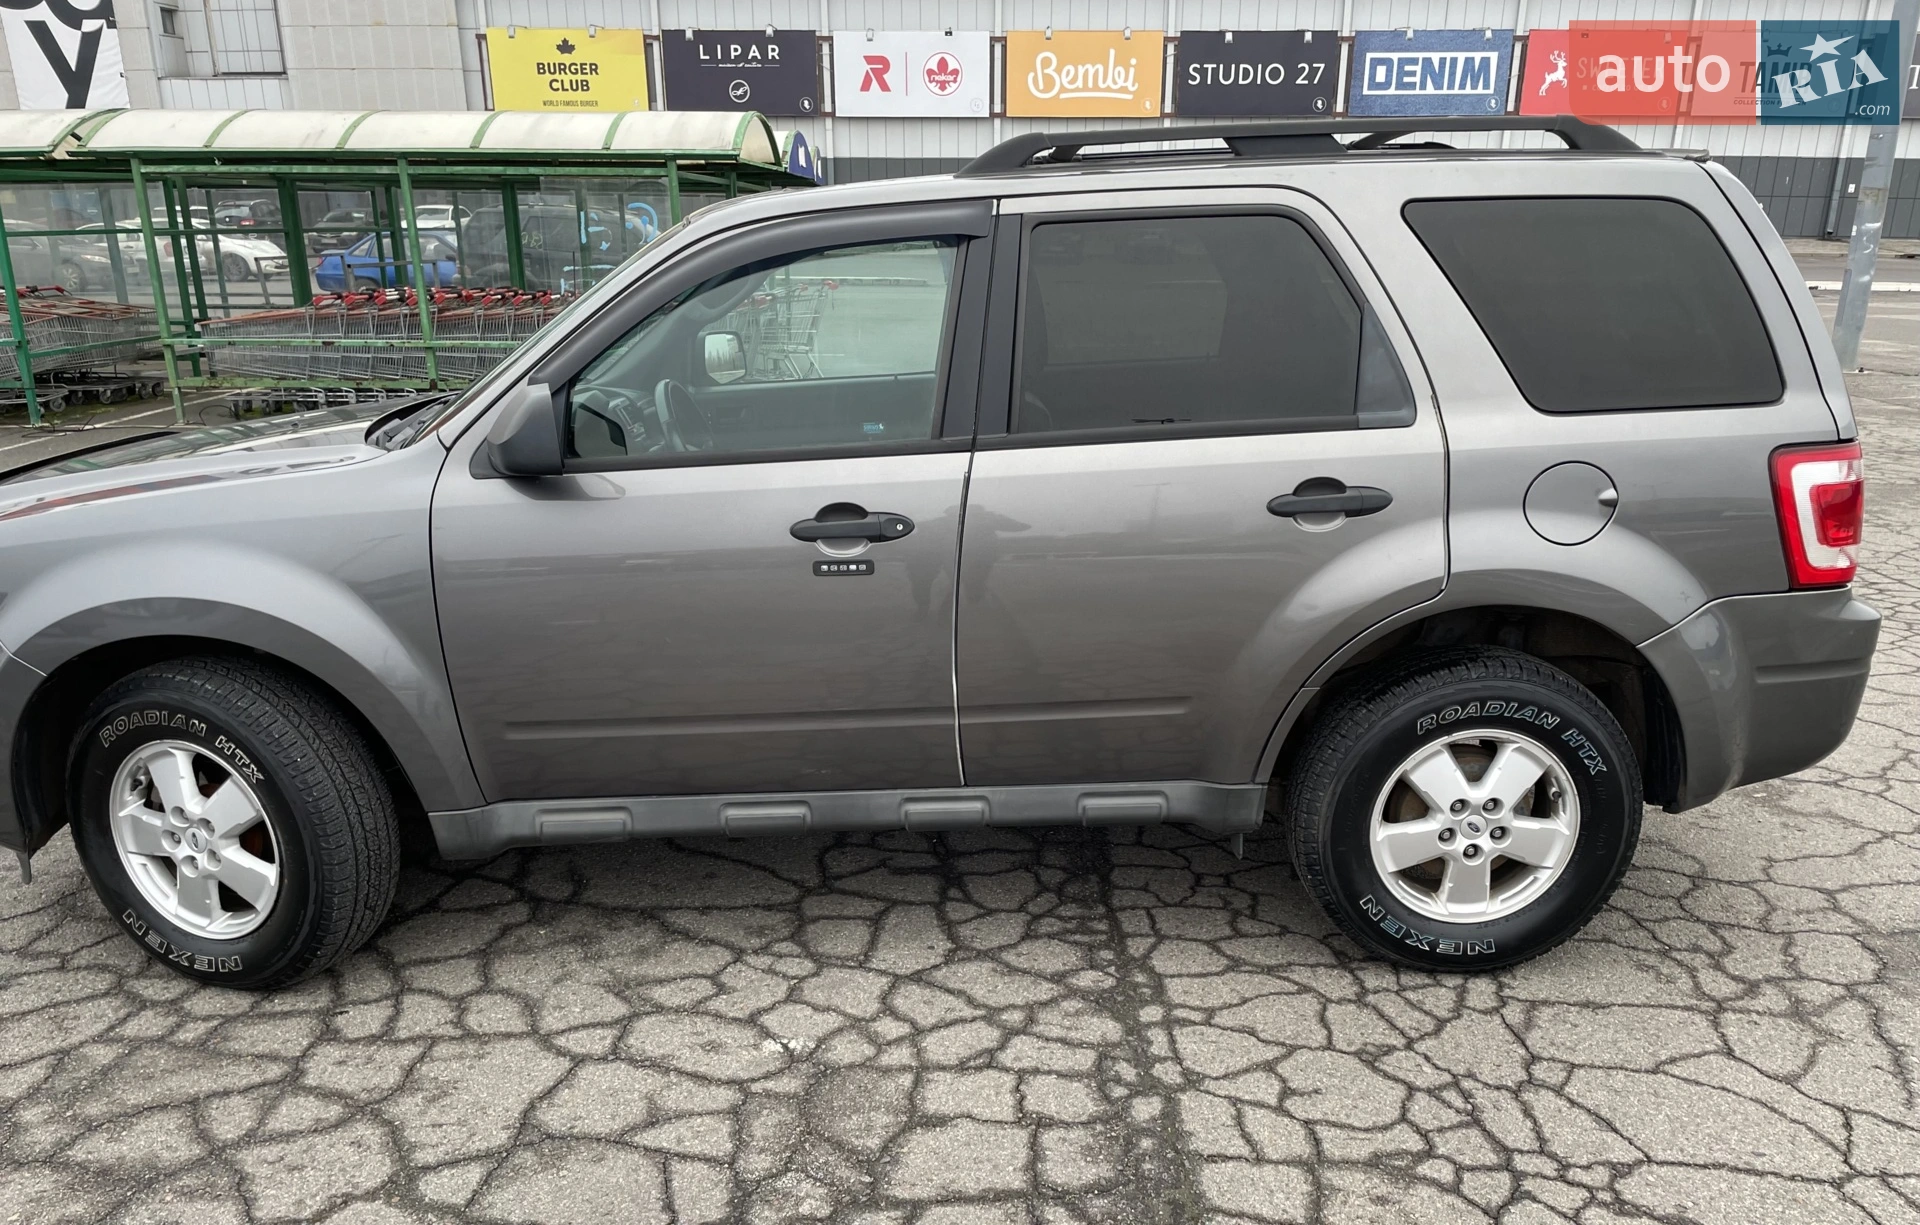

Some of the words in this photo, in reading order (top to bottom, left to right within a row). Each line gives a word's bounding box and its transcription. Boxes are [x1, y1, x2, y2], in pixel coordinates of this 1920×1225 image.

[536, 62, 600, 76] BURGER
[699, 44, 780, 60] LIPAR
[548, 78, 591, 92] CLUB
[859, 55, 892, 92] R
[1027, 48, 1139, 99] Bembi
[1188, 62, 1285, 86] STUDIO
[1295, 62, 1326, 85] 27
[1367, 56, 1491, 92] DENIM
[542, 99, 559, 107] WORLD
[560, 99, 579, 107] FAMOUS
[98, 709, 208, 748] ROADIAN
[215, 734, 265, 785] HTX
[1416, 700, 1561, 736] ROADIAN
[1560, 726, 1608, 777] HTX
[121, 908, 244, 974] NEXEN
[1359, 892, 1496, 957] NEXEN
